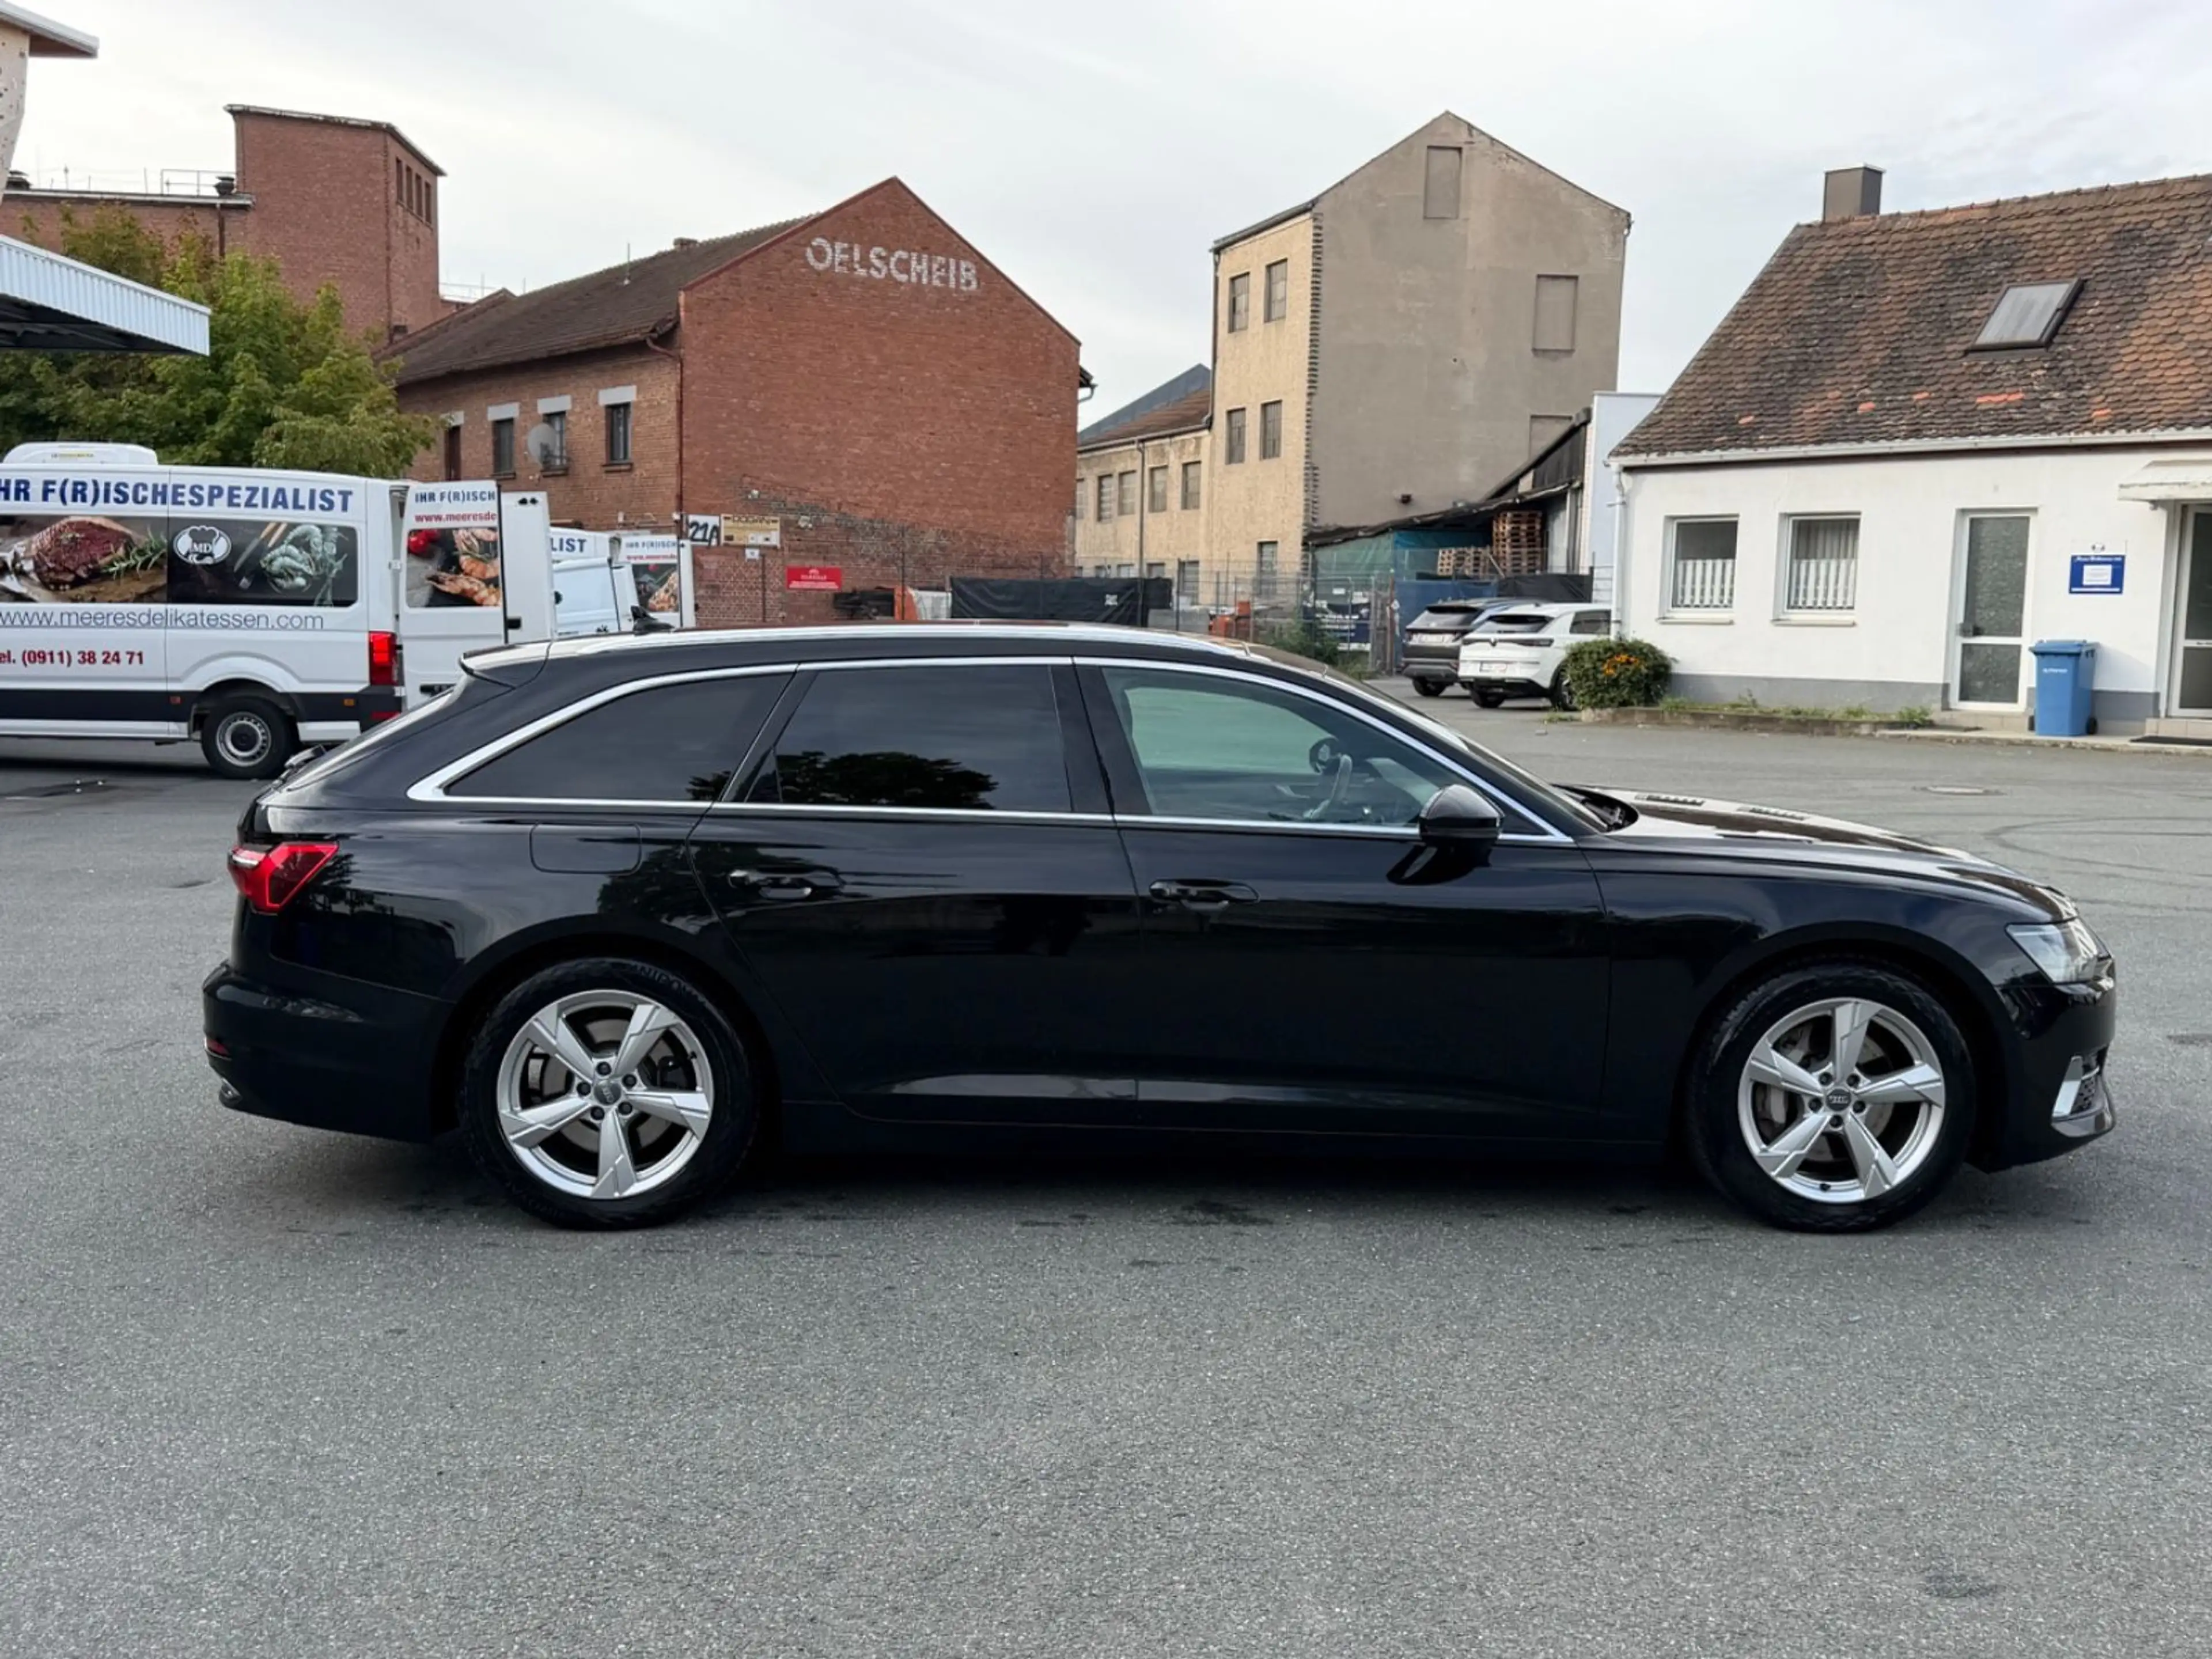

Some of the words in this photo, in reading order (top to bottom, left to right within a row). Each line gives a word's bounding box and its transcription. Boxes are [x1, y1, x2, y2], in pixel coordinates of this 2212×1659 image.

[805, 237, 978, 291] OELSCHEIB
[41, 478, 353, 512] F(R)ISCHESPEZIALIST
[414, 491, 436, 503] IHR
[439, 490, 496, 503] F(R)ISCH
[0, 608, 324, 630] www.meeresdelikatessen.com
[21, 649, 72, 668] (0911)
[77, 650, 97, 665] 38
[101, 650, 121, 665] 24
[125, 651, 144, 665] 71
